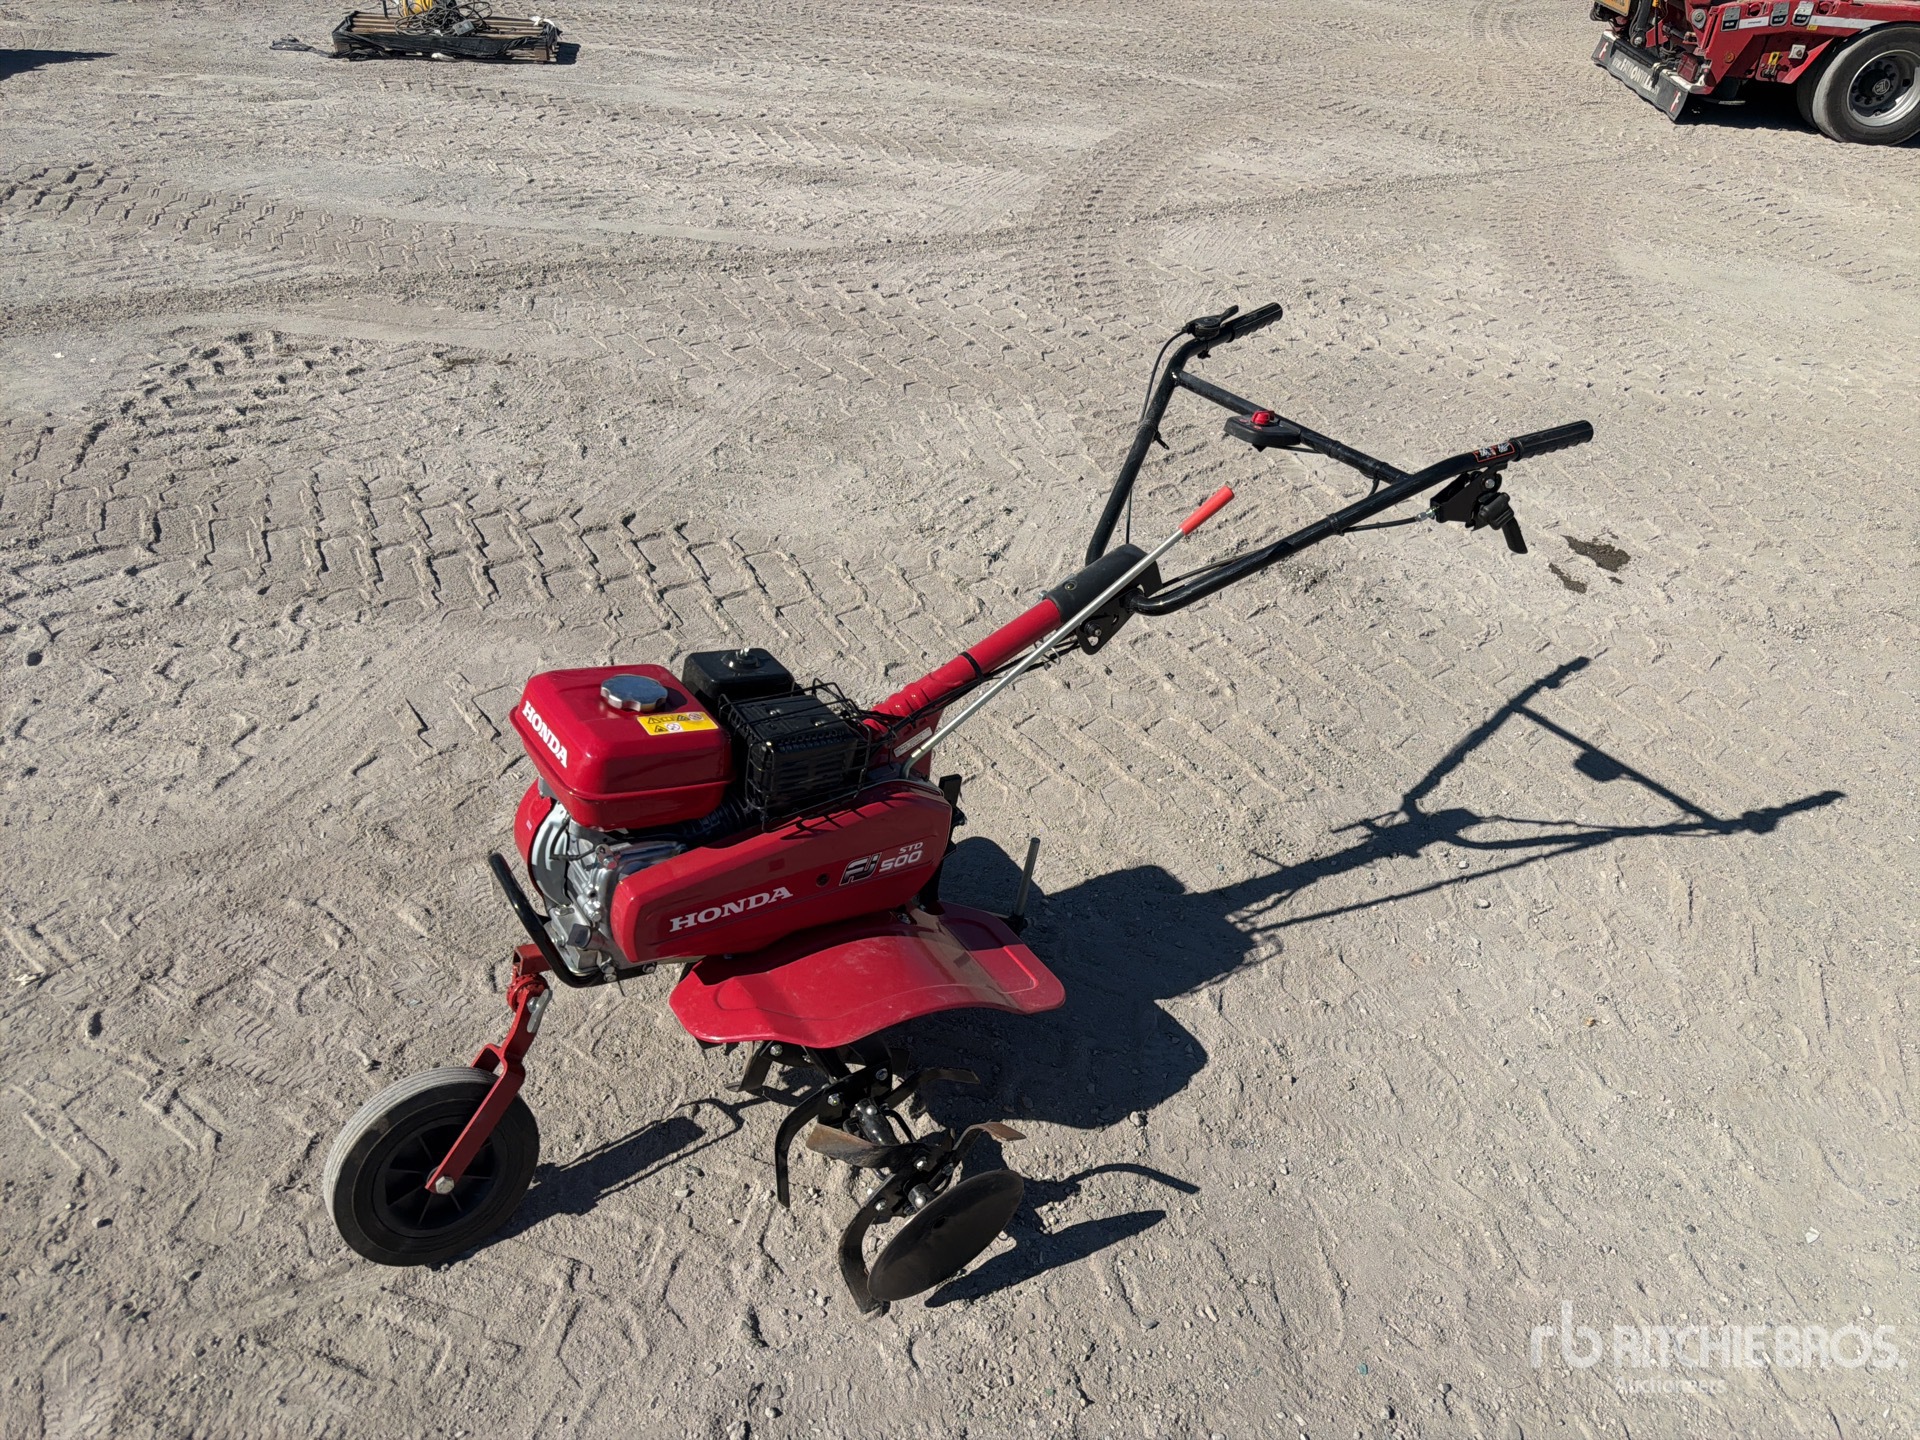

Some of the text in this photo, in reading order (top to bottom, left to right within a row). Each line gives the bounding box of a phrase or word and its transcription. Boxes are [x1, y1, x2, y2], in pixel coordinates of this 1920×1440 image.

[522, 700, 568, 768] HONDA
[879, 851, 923, 872] 500
[899, 842, 923, 855] STD
[669, 886, 794, 932] HONDA
